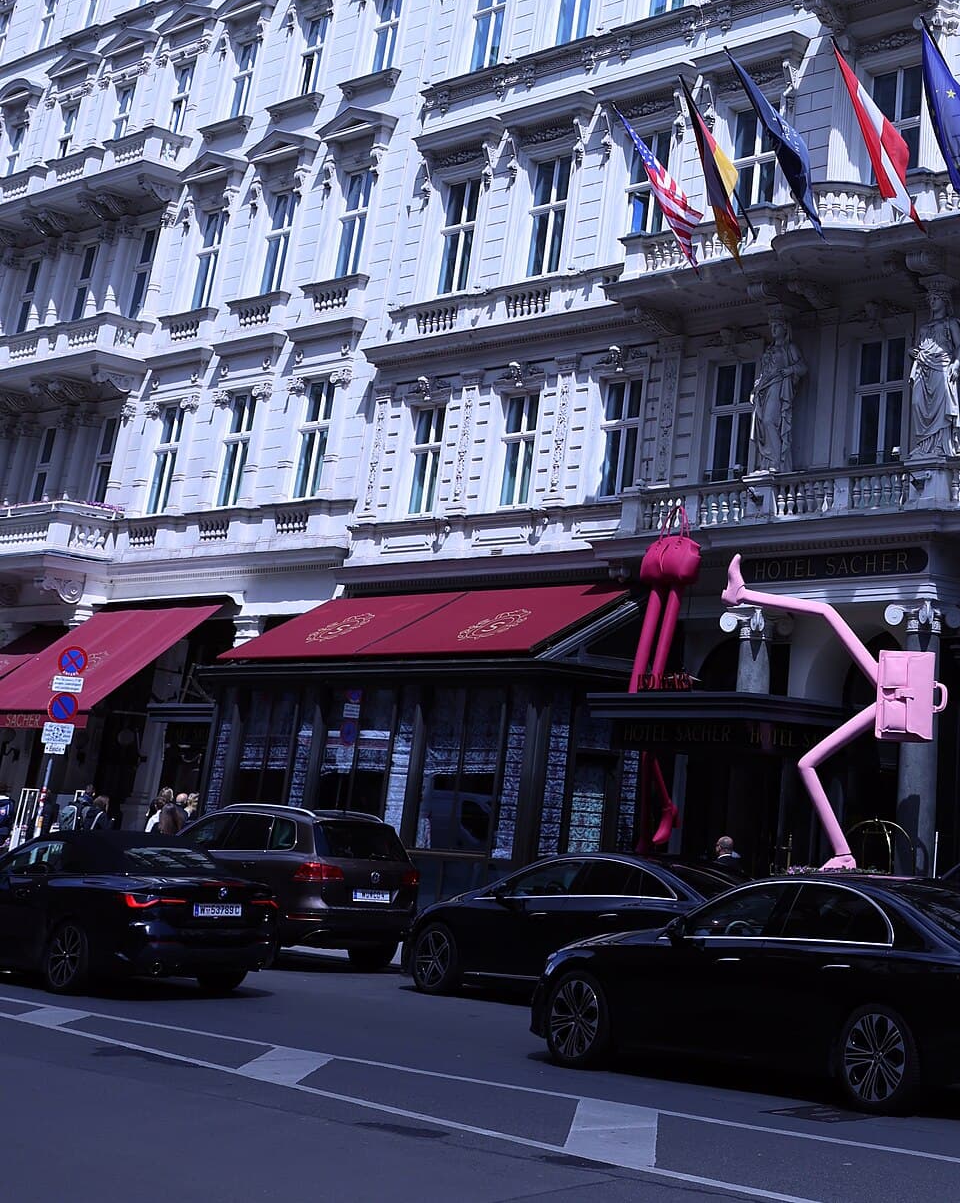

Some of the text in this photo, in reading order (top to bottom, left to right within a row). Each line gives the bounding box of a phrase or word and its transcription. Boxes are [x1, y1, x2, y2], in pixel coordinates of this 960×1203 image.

[754, 552, 911, 581] HOTEL SACHER
[5, 713, 42, 728] SACHER
[623, 723, 732, 742] HOTEL SACHER
